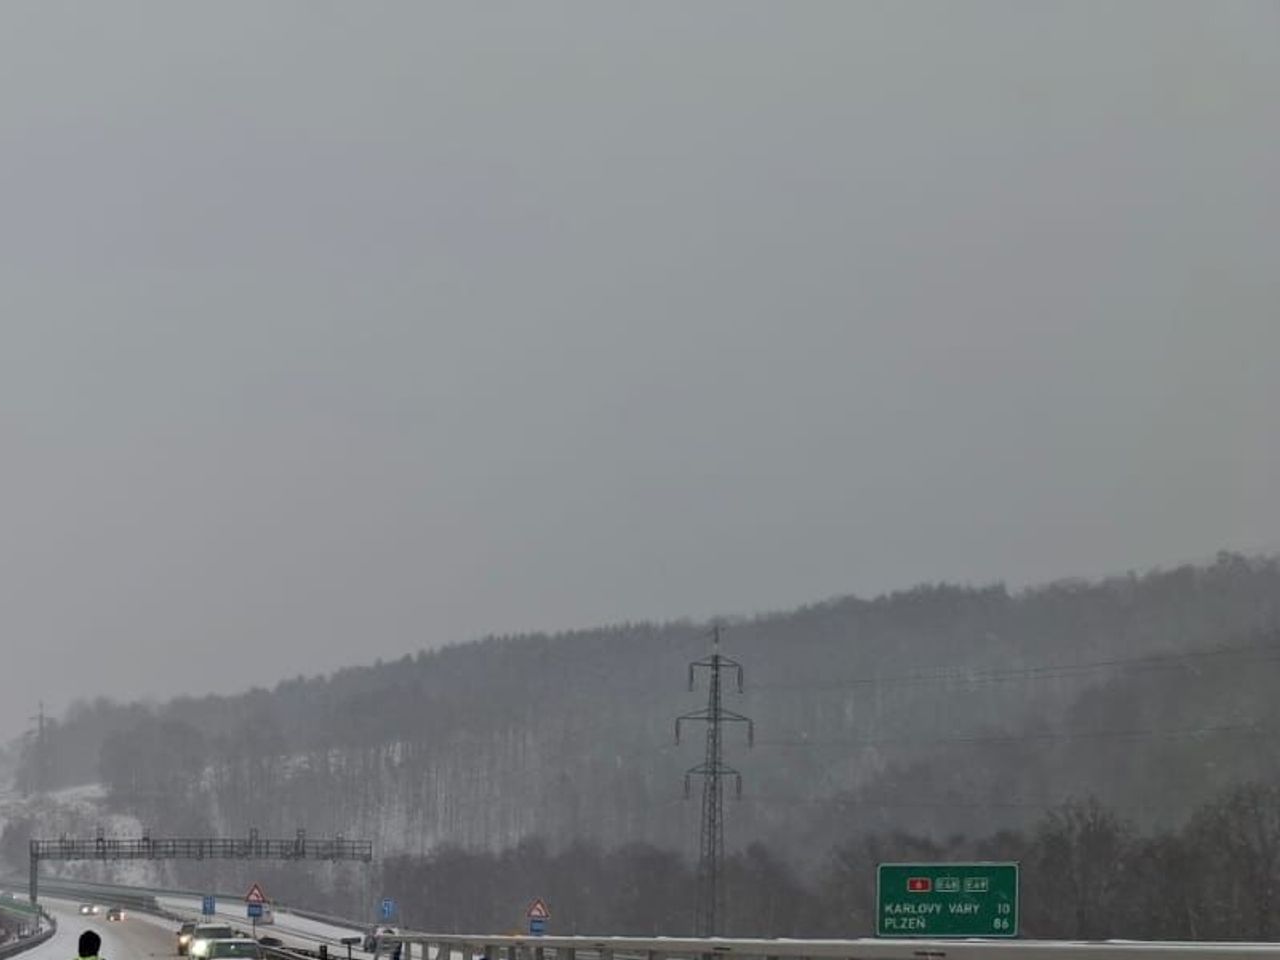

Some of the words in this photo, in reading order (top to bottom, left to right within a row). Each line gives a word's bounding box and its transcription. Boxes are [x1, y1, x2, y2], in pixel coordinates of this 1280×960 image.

[885, 903, 942, 914] KARLOVY
[948, 903, 980, 914] VARY
[997, 903, 1010, 914] 10
[885, 915, 926, 929] PLZEŇ
